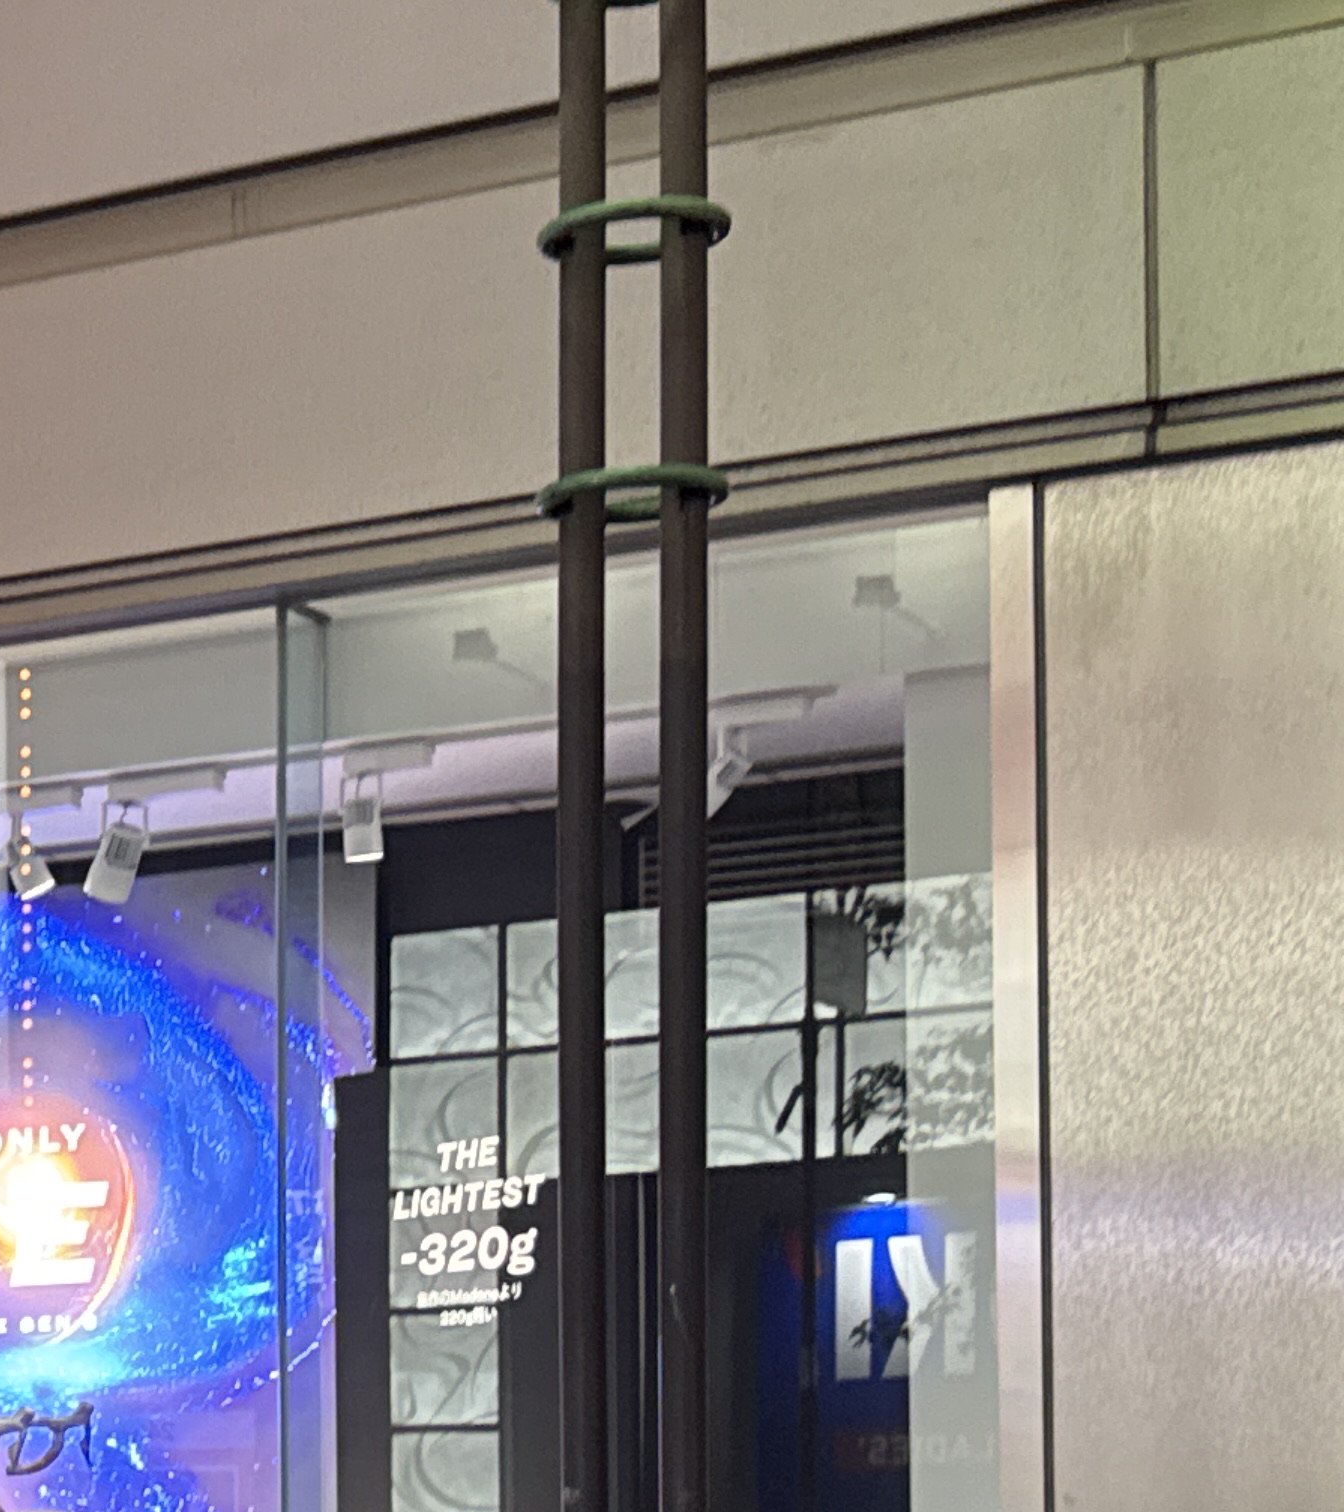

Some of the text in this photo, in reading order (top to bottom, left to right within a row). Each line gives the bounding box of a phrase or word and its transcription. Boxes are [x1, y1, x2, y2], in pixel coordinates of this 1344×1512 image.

[436, 1135, 500, 1173] THE
[393, 1173, 547, 1221] LIGHTEST
[400, 1225, 539, 1276] -320g
